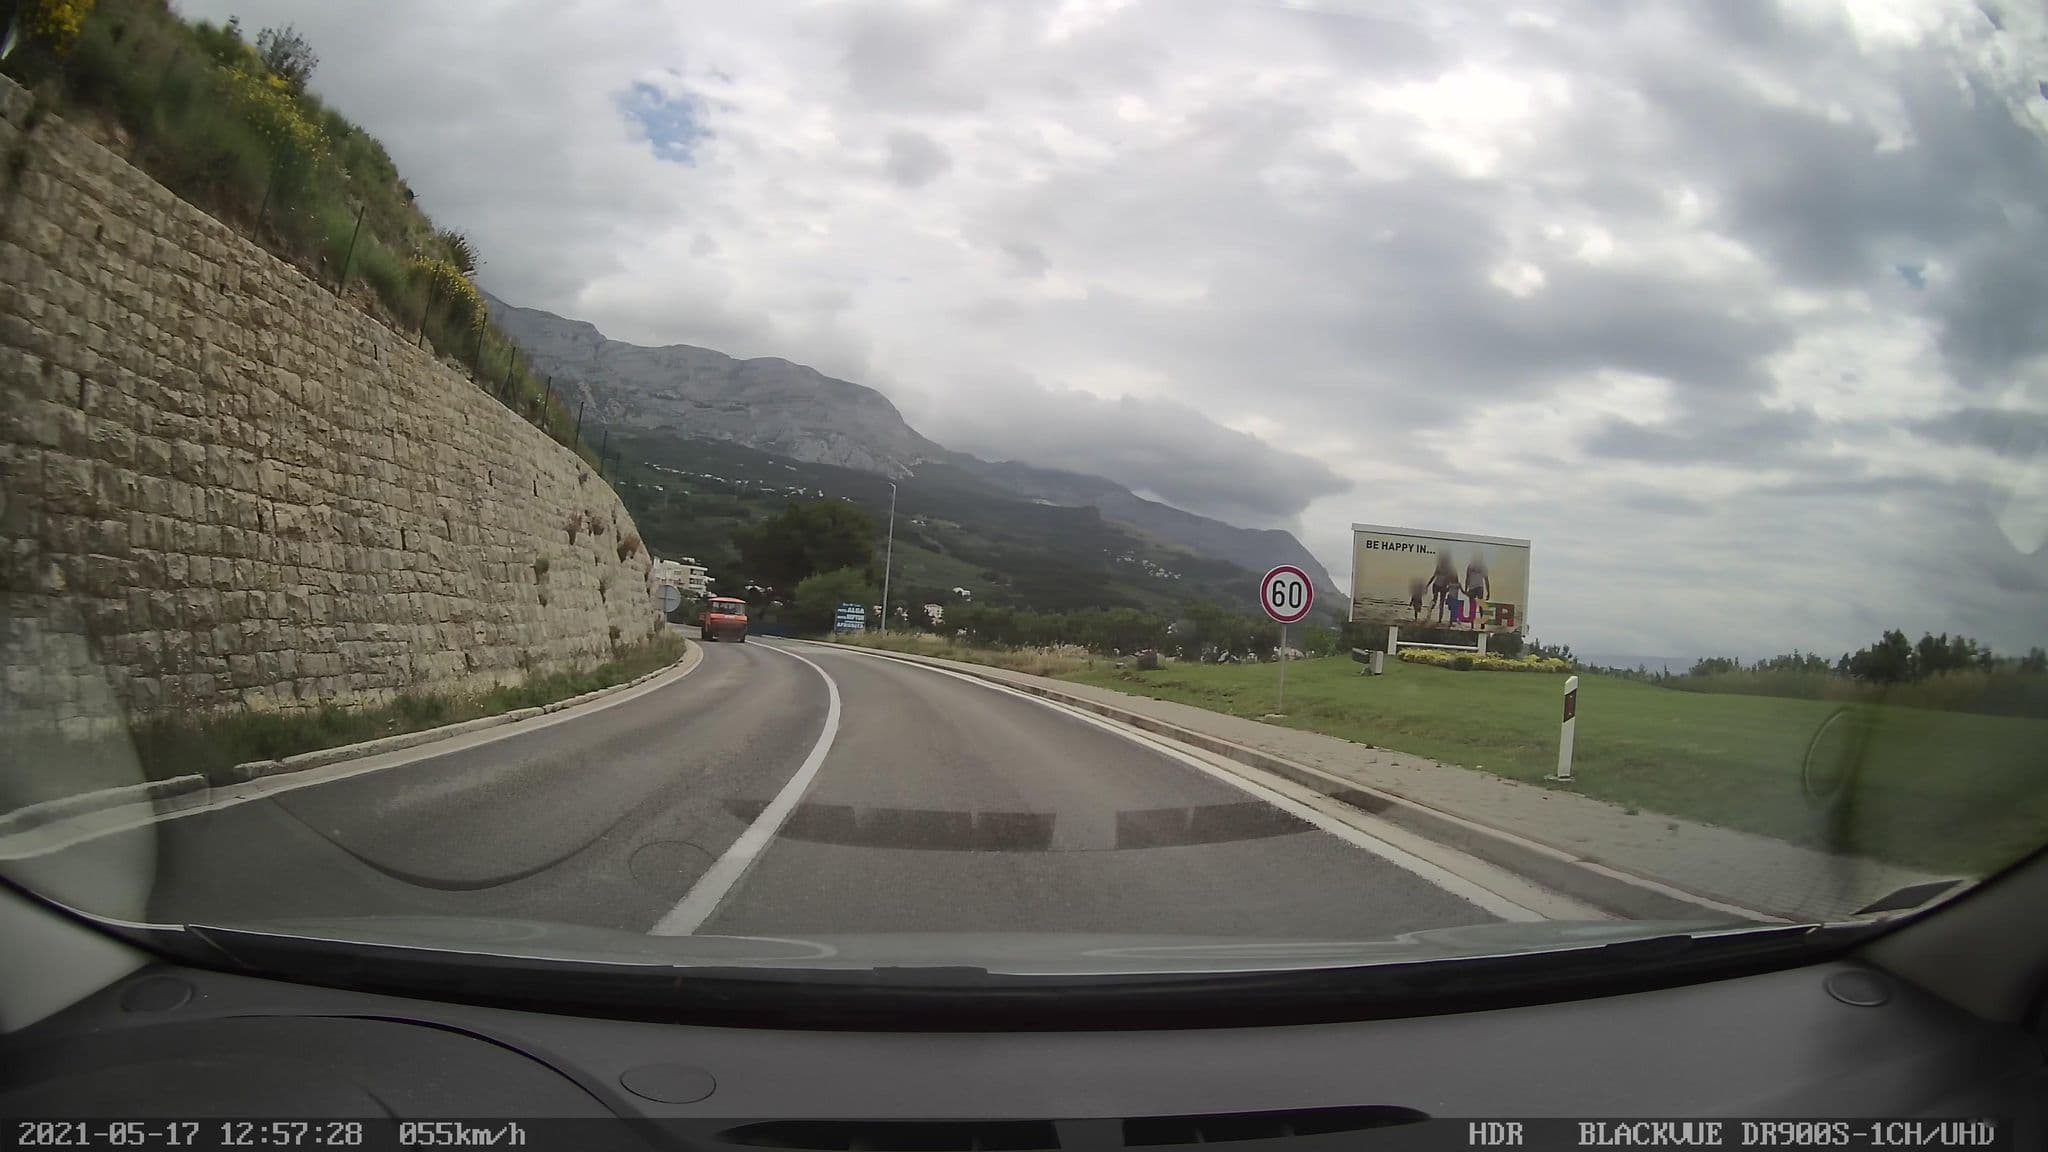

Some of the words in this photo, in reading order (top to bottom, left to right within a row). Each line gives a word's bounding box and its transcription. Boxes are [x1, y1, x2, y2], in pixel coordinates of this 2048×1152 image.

[1366, 540, 1379, 549] BE
[1381, 541, 1414, 553] HAPPY
[1272, 580, 1302, 608] 60
